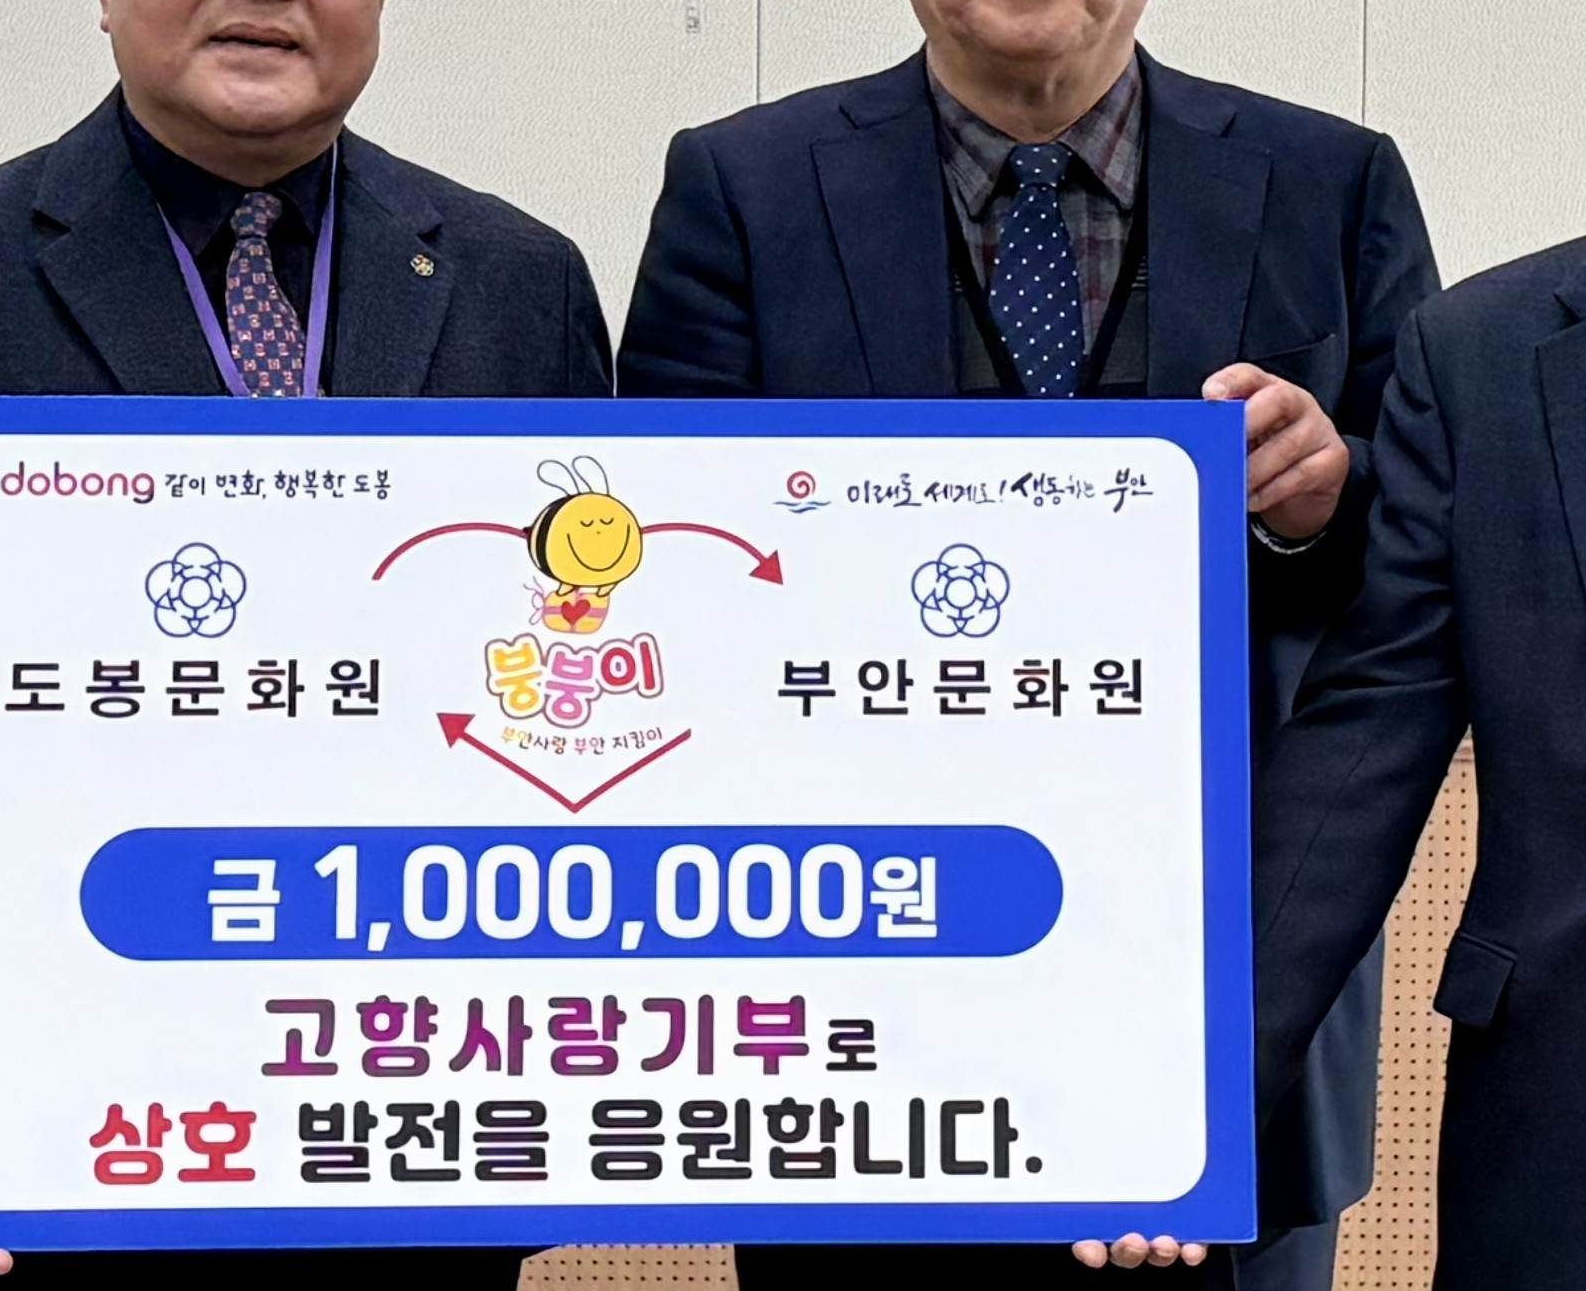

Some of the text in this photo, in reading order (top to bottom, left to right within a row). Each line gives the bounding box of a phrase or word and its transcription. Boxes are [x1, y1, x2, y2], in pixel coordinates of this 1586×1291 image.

[0, 461, 155, 504] dobong
[164, 473, 206, 498] 같이
[273, 469, 346, 499] 행복한
[353, 469, 392, 501] 도봉
[1103, 468, 1154, 513] 부안
[4, 658, 381, 719] 도봉문화원
[490, 638, 658, 722] 붕붕이
[777, 658, 1142, 718] 부안문화원
[574, 736, 606, 755] 부안
[207, 843, 939, 952] 금 1,000,000원
[260, 994, 878, 1078] 고향사랑기부로
[88, 1096, 1044, 1186] 상호 발전을 응원합니다.
